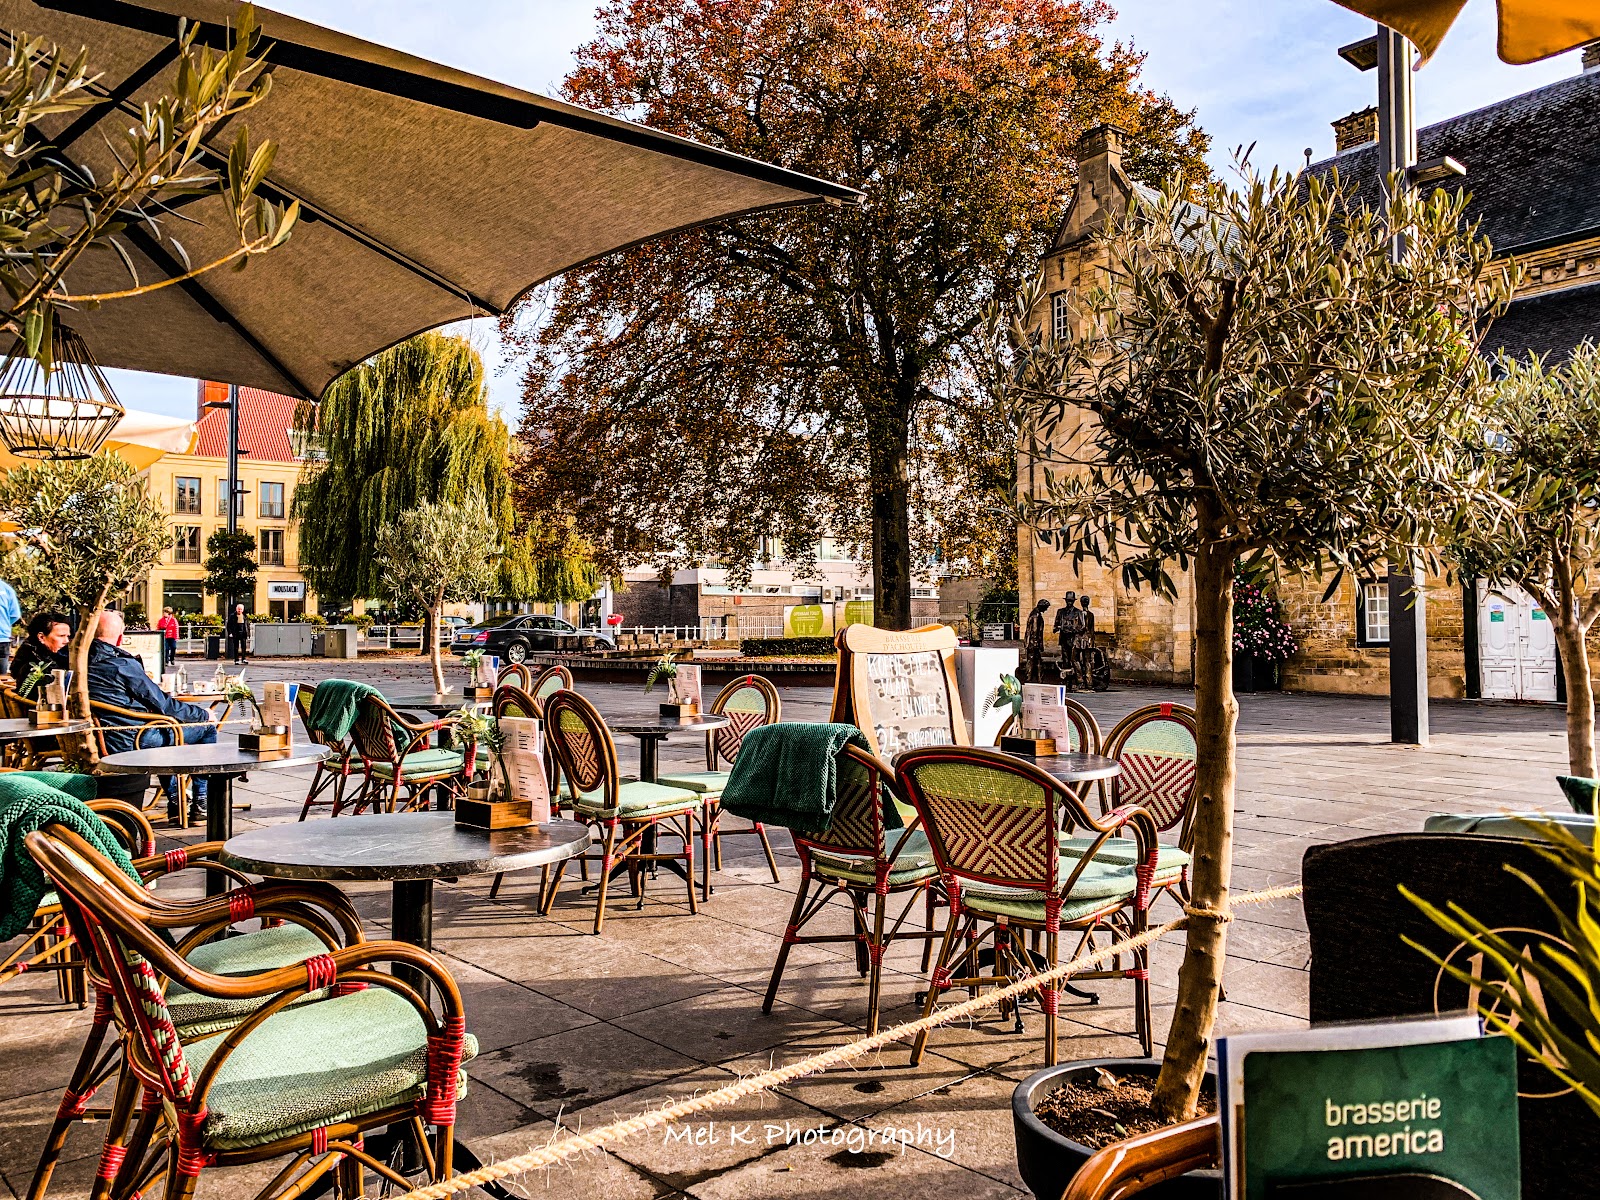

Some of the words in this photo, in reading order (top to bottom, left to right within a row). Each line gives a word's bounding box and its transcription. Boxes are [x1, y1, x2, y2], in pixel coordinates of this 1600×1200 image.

[867, 654, 904, 677] KOFFIE
[908, 653, 933, 676] MET
[900, 695, 938, 718] LUNCH
[876, 726, 901, 757] 24
[1325, 1092, 1441, 1127] brasserie
[1327, 1125, 1444, 1161] america
